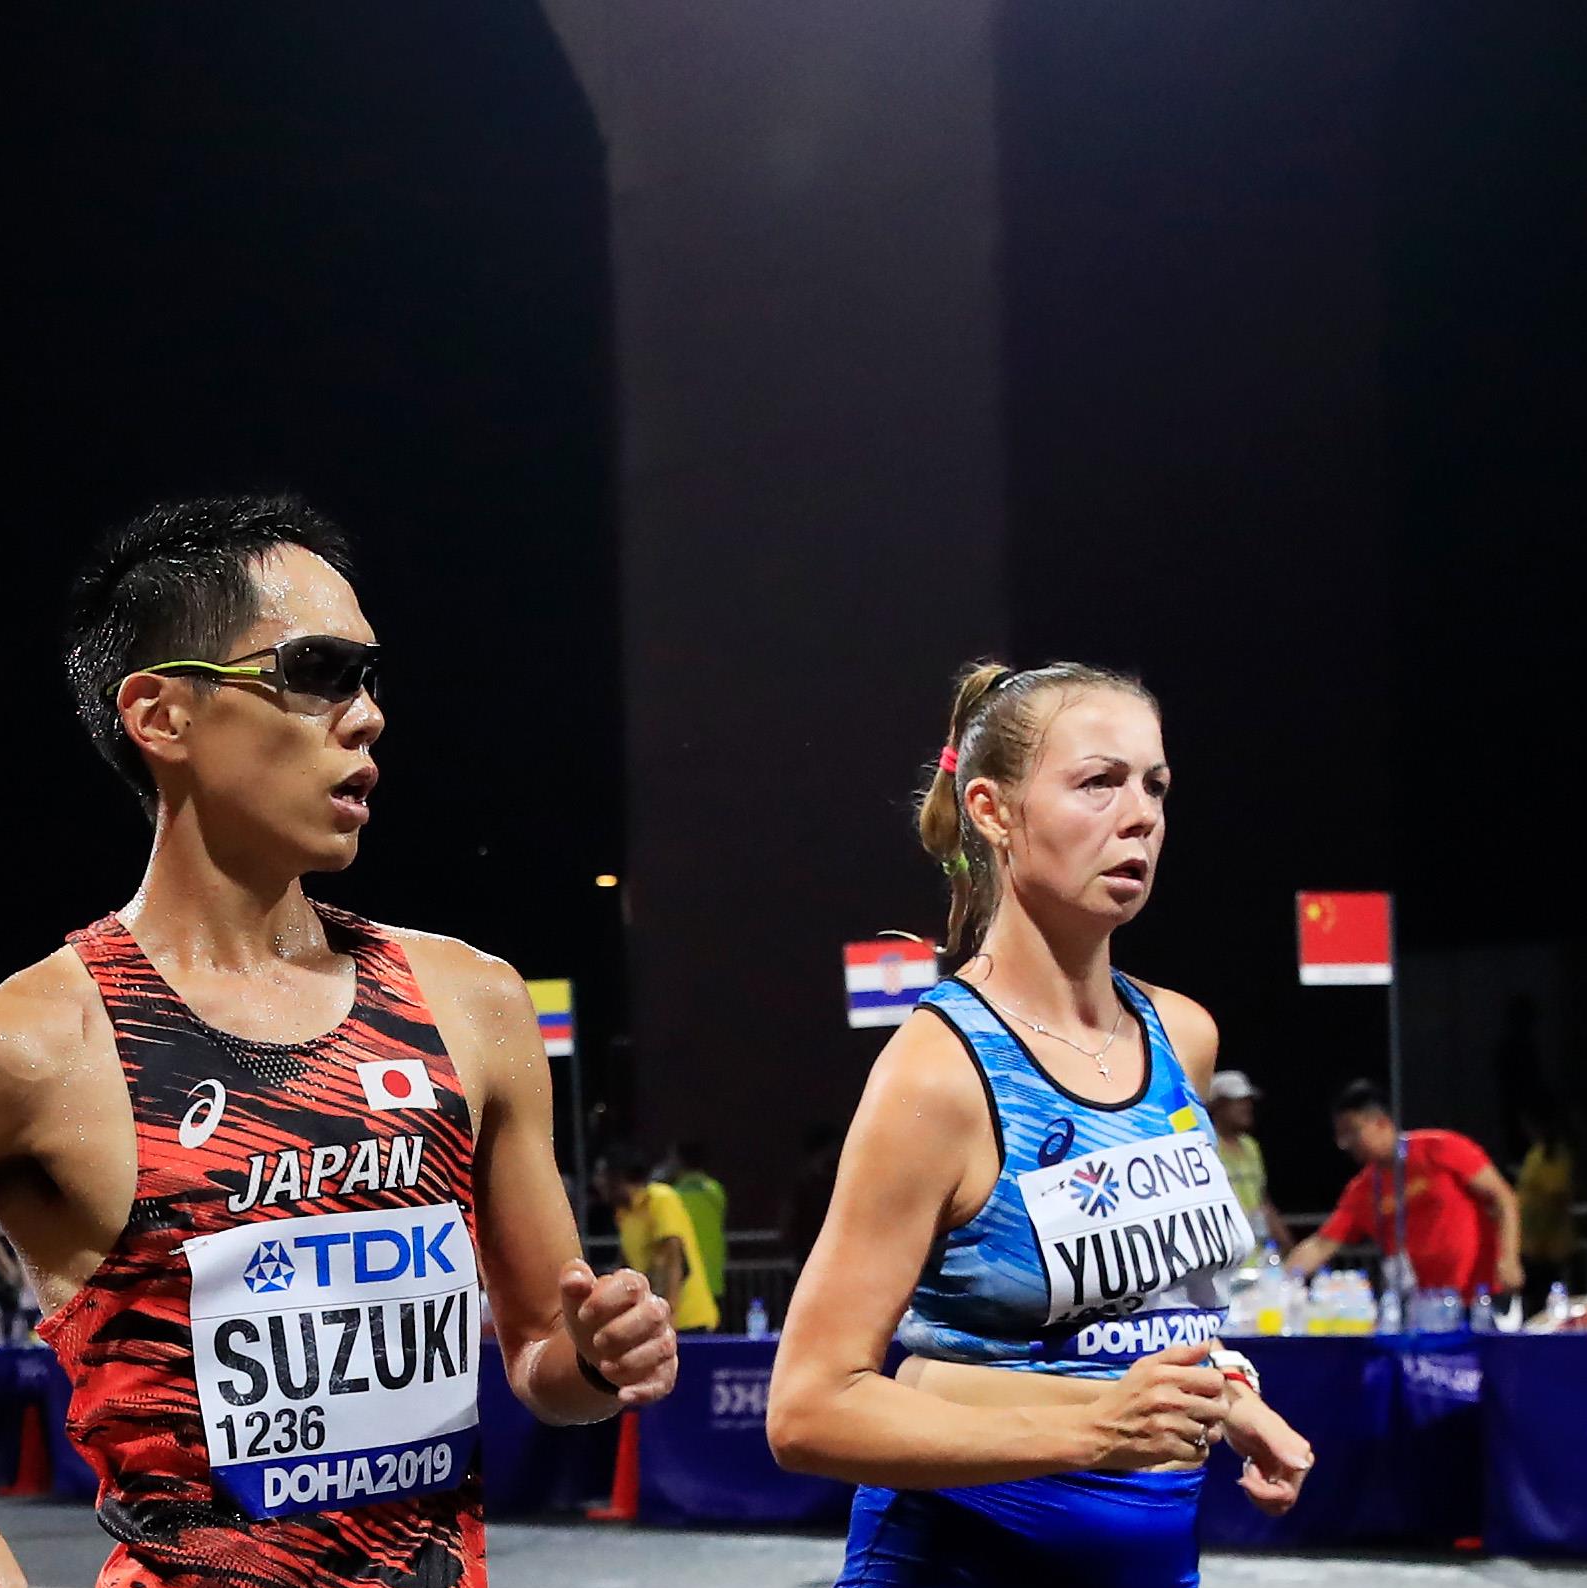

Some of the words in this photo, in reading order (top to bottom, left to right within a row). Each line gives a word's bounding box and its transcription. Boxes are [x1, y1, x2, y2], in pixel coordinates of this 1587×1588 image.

[228, 1136, 426, 1213] JAPAN
[1126, 1147, 1211, 1200] QNB
[294, 1221, 457, 1288] TDK
[213, 1291, 469, 1407] SUZUKI
[216, 1405, 326, 1461] 1236
[263, 1443, 453, 1508] DOHA2019
